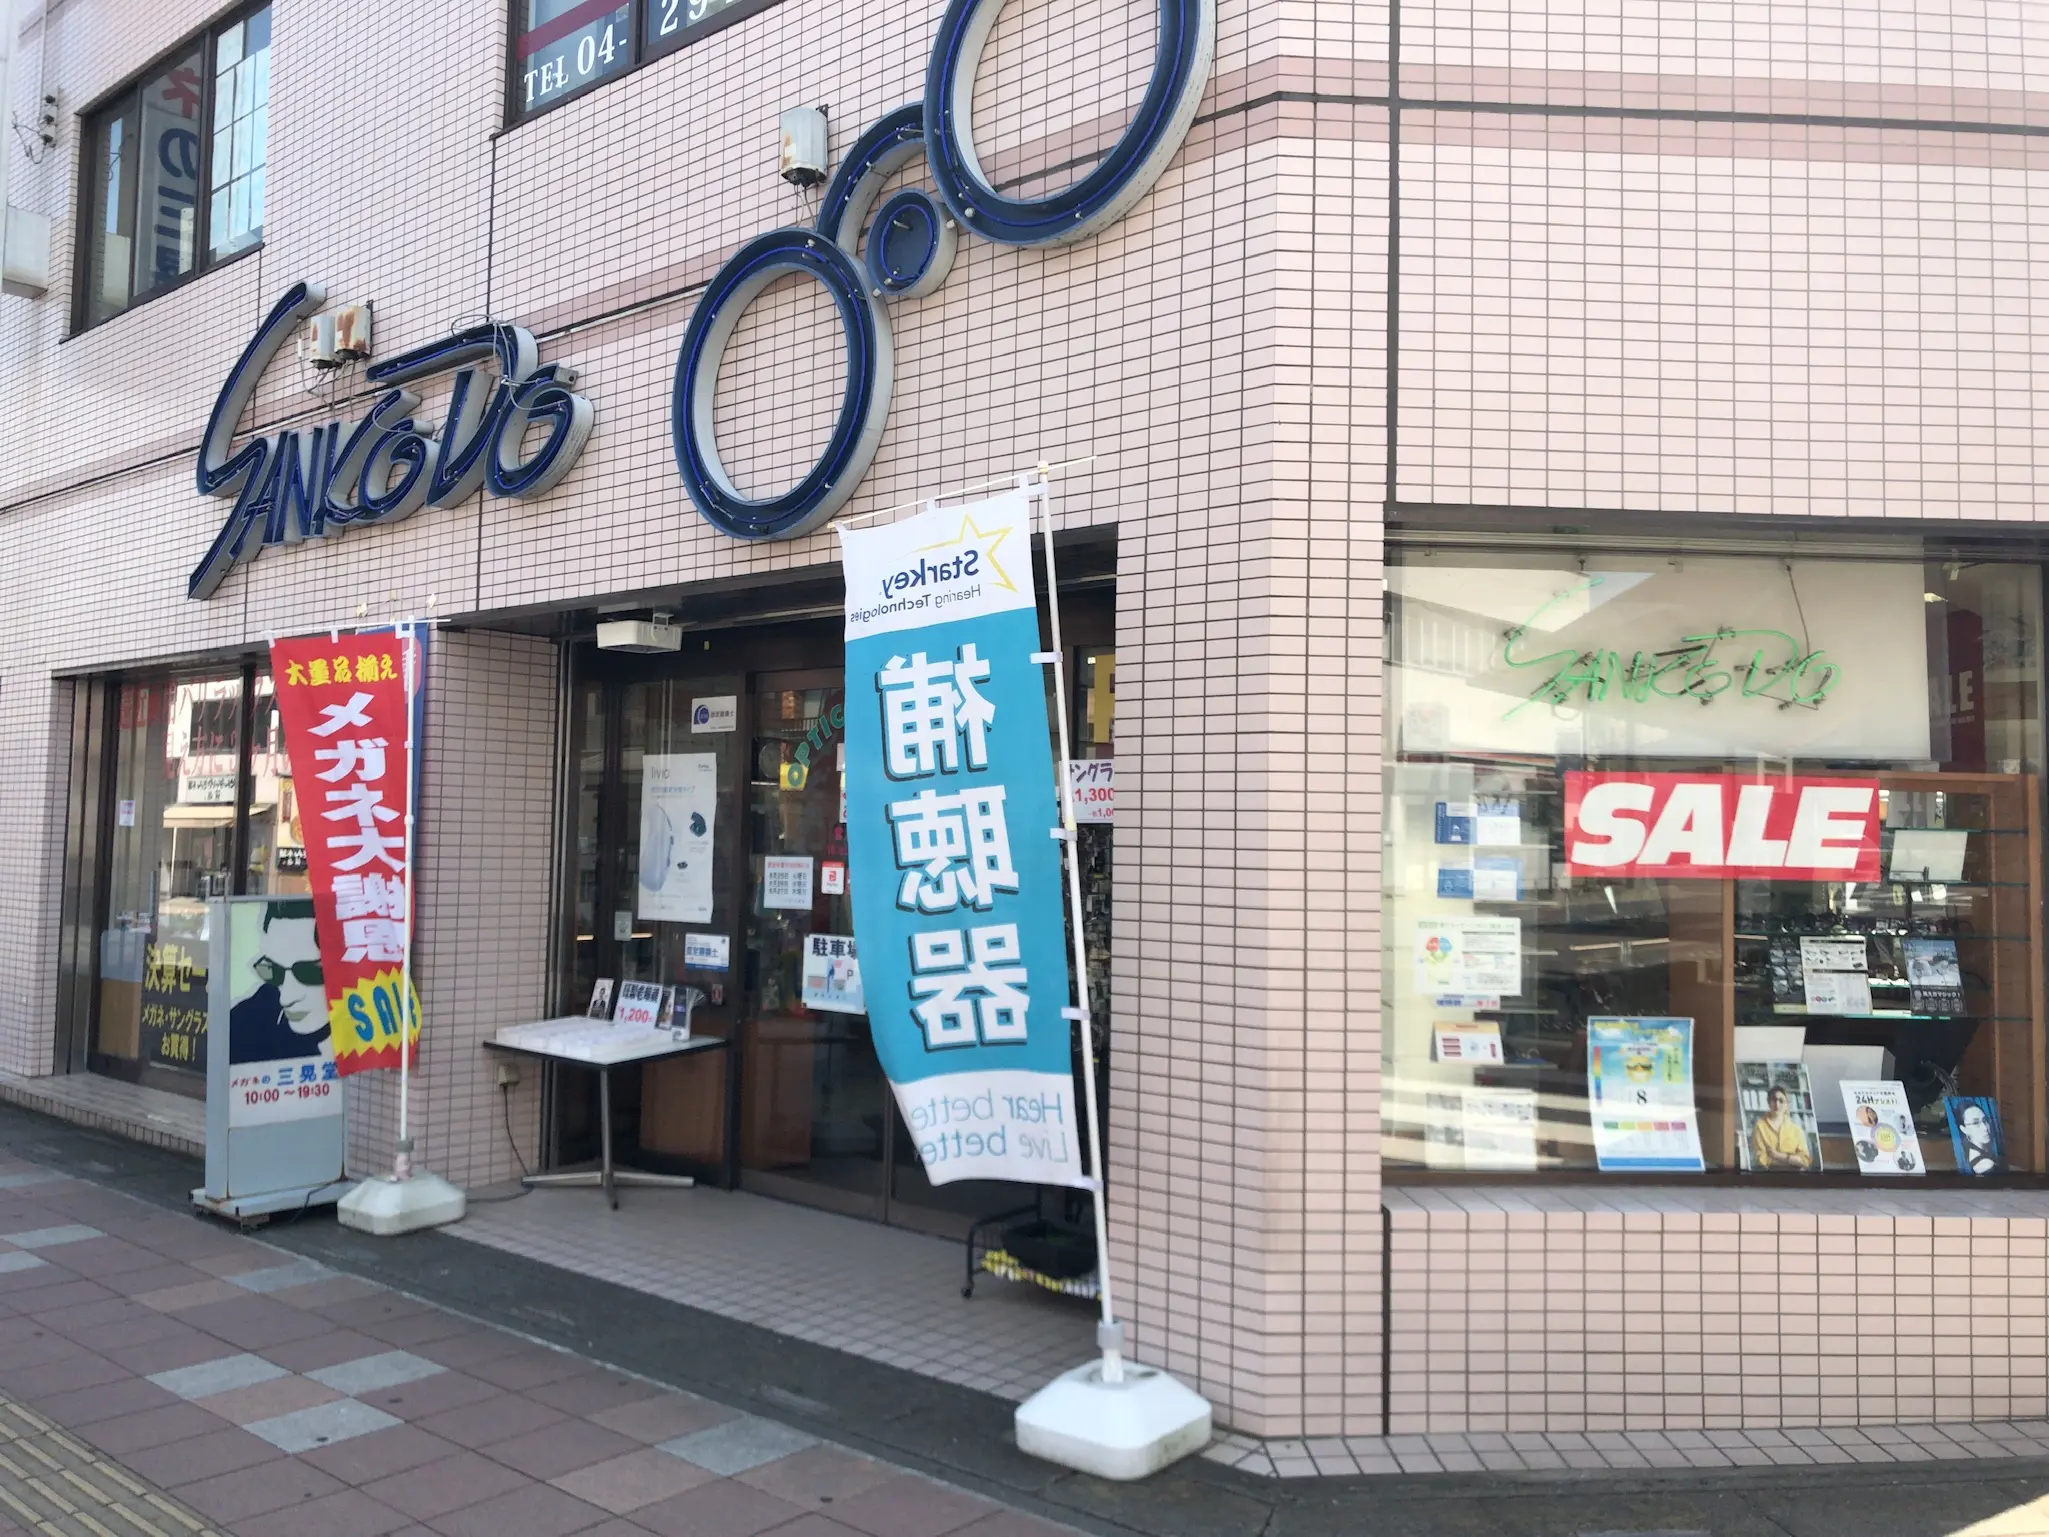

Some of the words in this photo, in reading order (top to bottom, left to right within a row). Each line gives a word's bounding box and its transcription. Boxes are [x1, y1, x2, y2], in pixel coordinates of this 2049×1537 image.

[524, 55, 568, 103] TEL
[577, 23, 627, 75] 04-
[284, 655, 399, 688] 大量品揃え
[1571, 782, 1874, 870] SALE
[144, 942, 209, 995] 決算セー
[1636, 1089, 1648, 1105] 8
